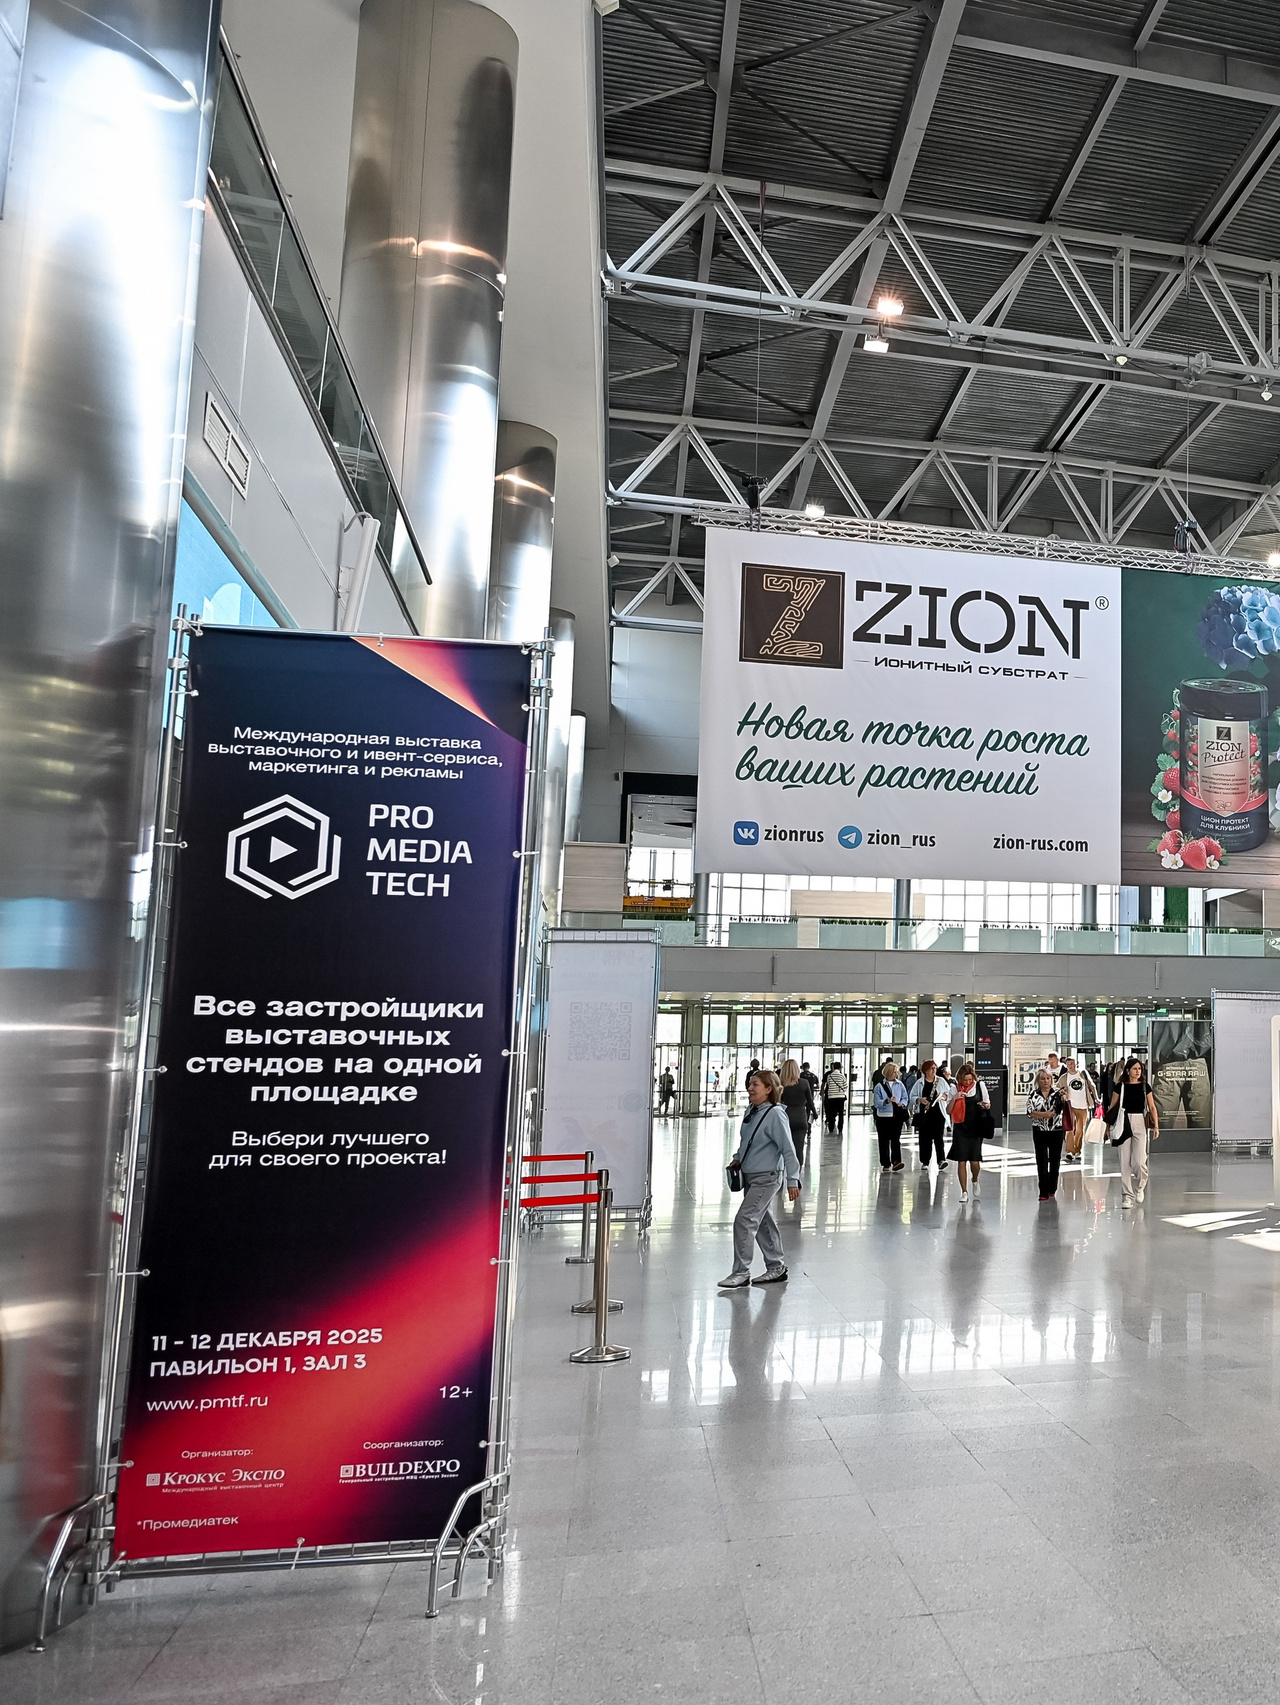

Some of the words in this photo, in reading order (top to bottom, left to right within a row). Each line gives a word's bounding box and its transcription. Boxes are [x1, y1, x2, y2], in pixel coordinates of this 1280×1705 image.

[852, 580, 1090, 660] ZION
[978, 665, 1068, 681] СУБСТРАТ
[233, 726, 390, 745] Международная
[395, 736, 482, 750] выставка
[736, 701, 854, 743] Новая
[861, 720, 974, 750] точка
[975, 727, 1091, 761] роста
[208, 743, 342, 759] выставочного
[347, 750, 358, 760] и
[363, 750, 503, 768] ивент-сервиса,
[1205, 740, 1242, 752] ZION
[1201, 750, 1246, 763] Protect
[248, 761, 359, 776] маркетинга
[364, 765, 376, 775] и
[380, 766, 464, 780] рекламы
[734, 745, 855, 791] ваших
[857, 762, 1040, 798] растений
[368, 804, 434, 829] PRO
[764, 825, 824, 843] zionrus
[867, 830, 936, 849] zion_rus
[367, 838, 473, 864] MEDIA
[993, 836, 1089, 853] zion-rus.com
[366, 871, 451, 897] TECH
[193, 995, 256, 1017] Все
[266, 996, 484, 1022] застройщики
[225, 1027, 451, 1046] выставочных
[186, 1056, 323, 1075] стендов
[334, 1057, 373, 1074] на
[383, 1053, 482, 1076] одной
[250, 1084, 418, 1105] площадке
[231, 1131, 324, 1150] Выбери
[330, 1131, 430, 1149] лучшего
[208, 1152, 252, 1169] для
[259, 1151, 340, 1167] своего
[347, 1149, 447, 1169] проекта!
[152, 1336, 167, 1352] 11
[190, 1334, 212, 1351] 12
[217, 1330, 322, 1352] ДЕКАБРЯ
[327, 1328, 383, 1345] 2025
[150, 1357, 278, 1378] ПАВИЛЬОН
[284, 1356, 297, 1375] 1,
[302, 1355, 348, 1374] ЗАЛ
[354, 1354, 367, 1371] 3
[439, 1385, 474, 1400] 12+
[146, 1395, 269, 1412] www.pmtf.ru
[181, 1448, 254, 1460] Организатор:
[363, 1439, 444, 1451] Соорганизатор:
[355, 1459, 461, 1478] BUILDEXPO
